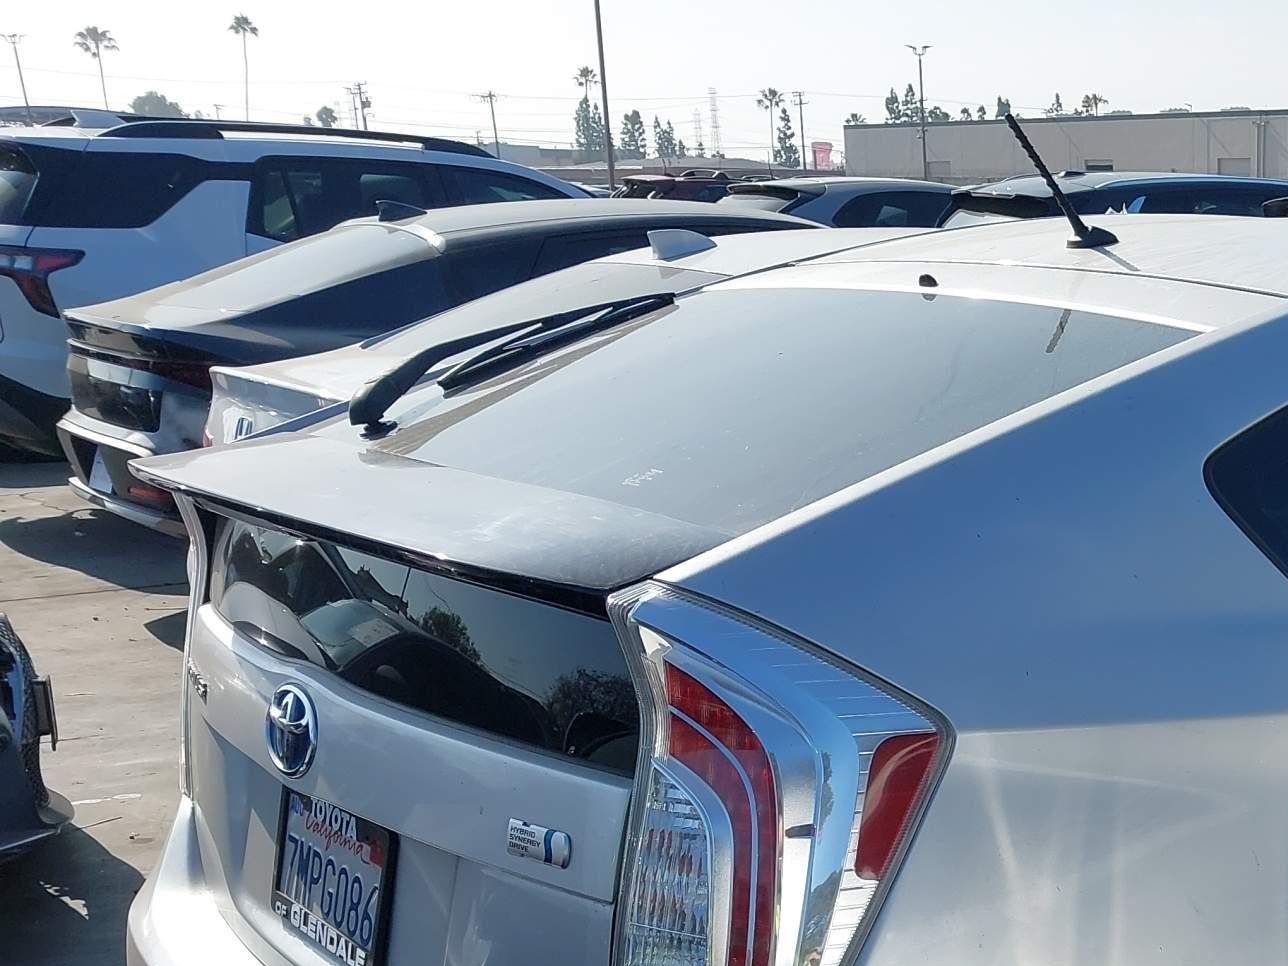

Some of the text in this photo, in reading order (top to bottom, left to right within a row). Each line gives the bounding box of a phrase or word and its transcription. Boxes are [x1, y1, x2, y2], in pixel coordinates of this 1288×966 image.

[310, 797, 358, 841] TOYOTA
[510, 825, 536, 839] HYBRID
[508, 841, 529, 853] DRIVE
[509, 833, 541, 848] SYNERGY
[284, 833, 379, 948] 7MPG086
[275, 900, 287, 917] OF
